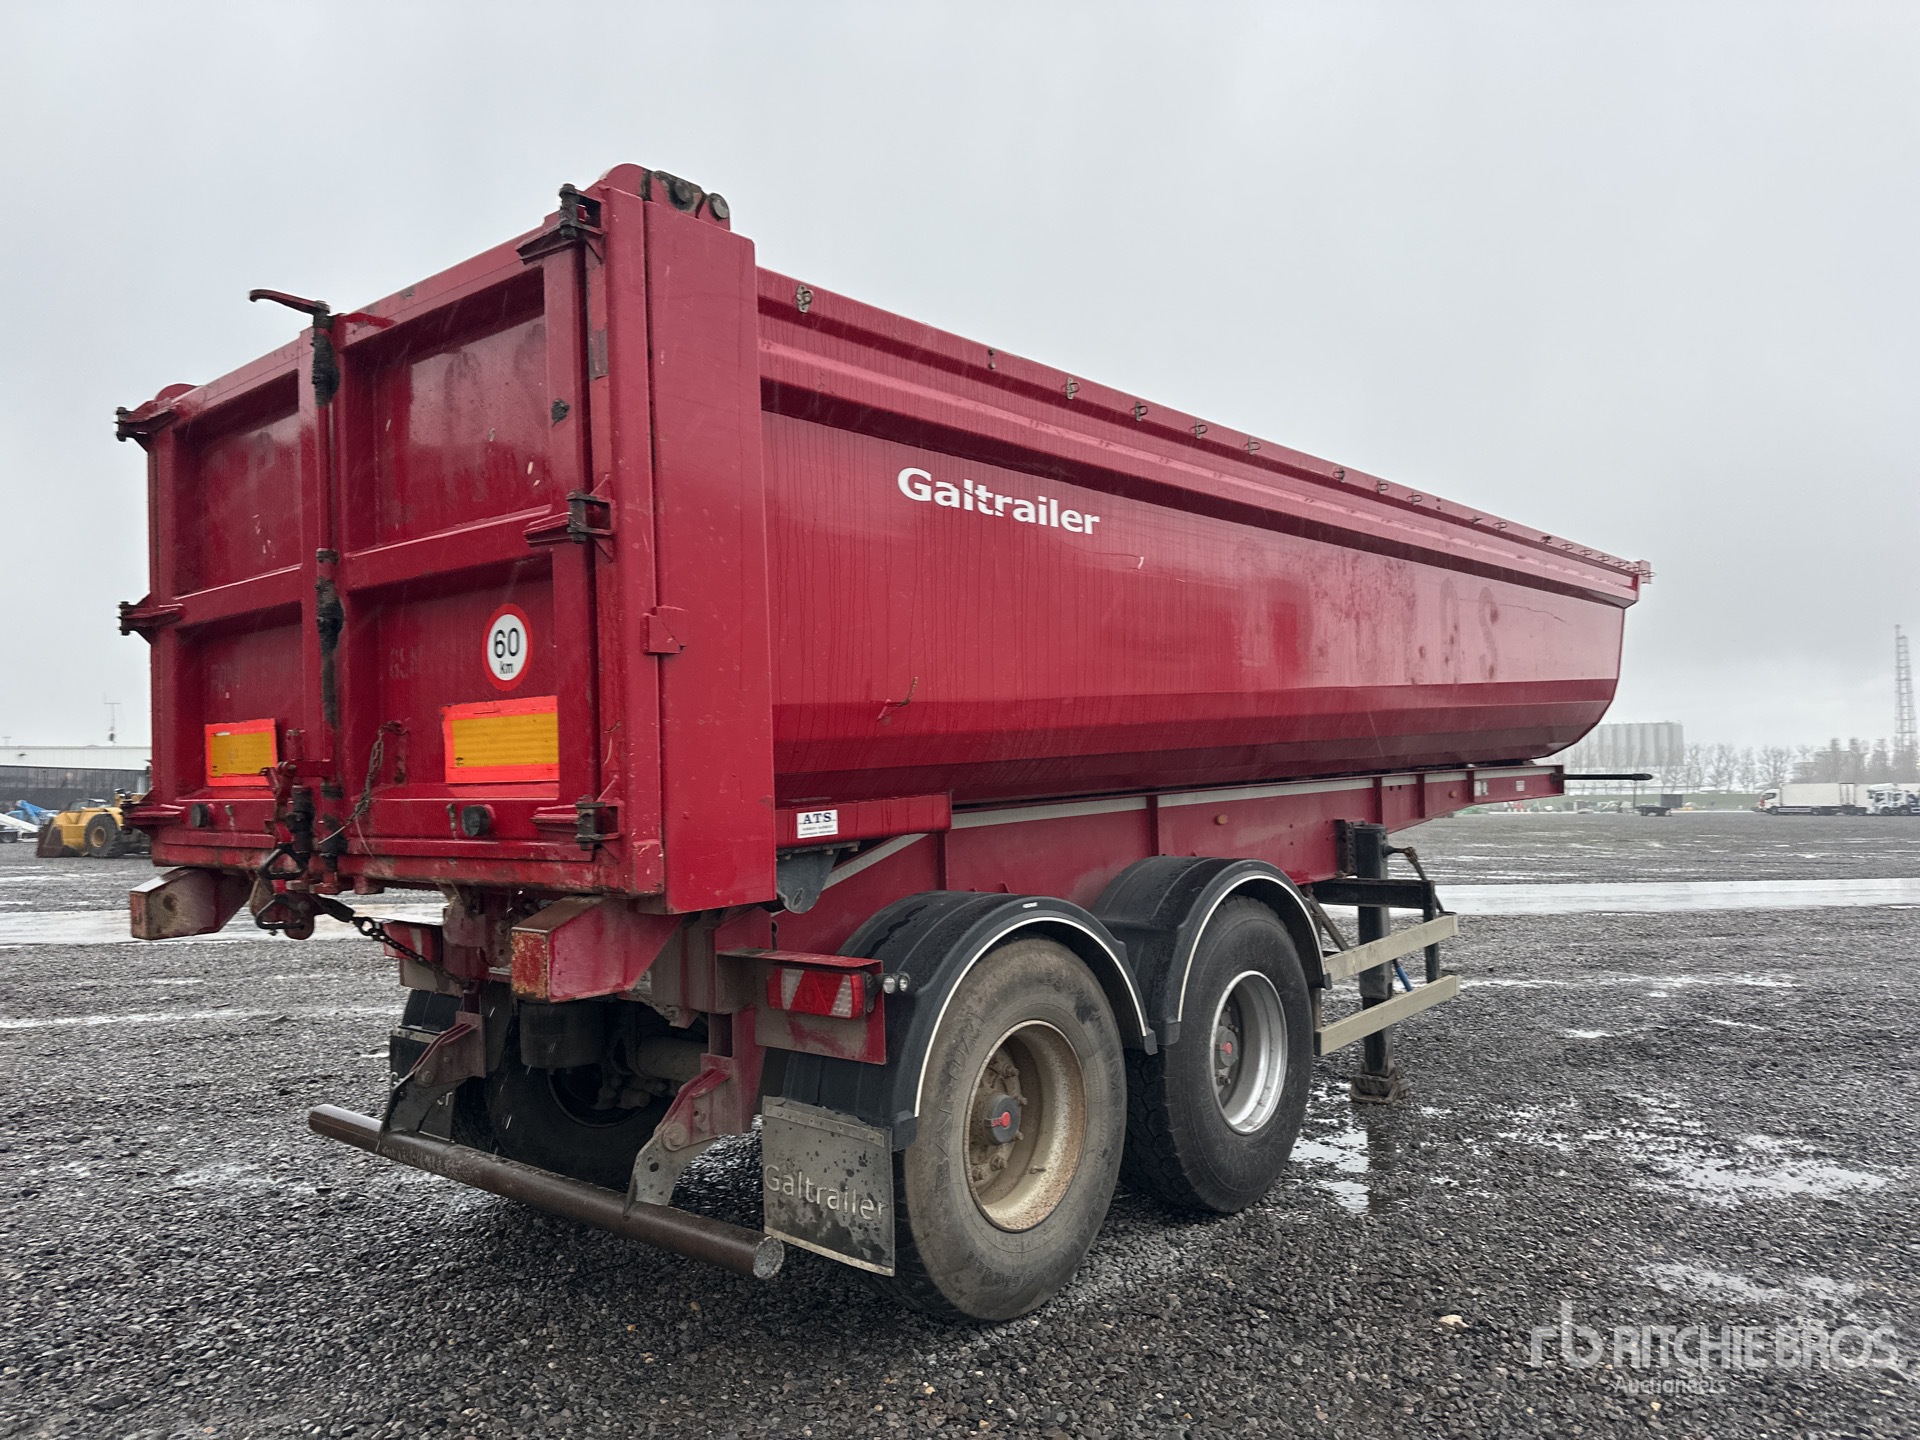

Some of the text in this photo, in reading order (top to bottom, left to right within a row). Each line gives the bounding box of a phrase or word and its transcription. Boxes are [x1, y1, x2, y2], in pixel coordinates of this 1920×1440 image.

[898, 467, 1100, 535] Galtrailer
[494, 627, 520, 658] 60
[500, 661, 514, 675] km
[803, 812, 832, 825] ATS
[764, 1164, 886, 1222] Galtrailer
